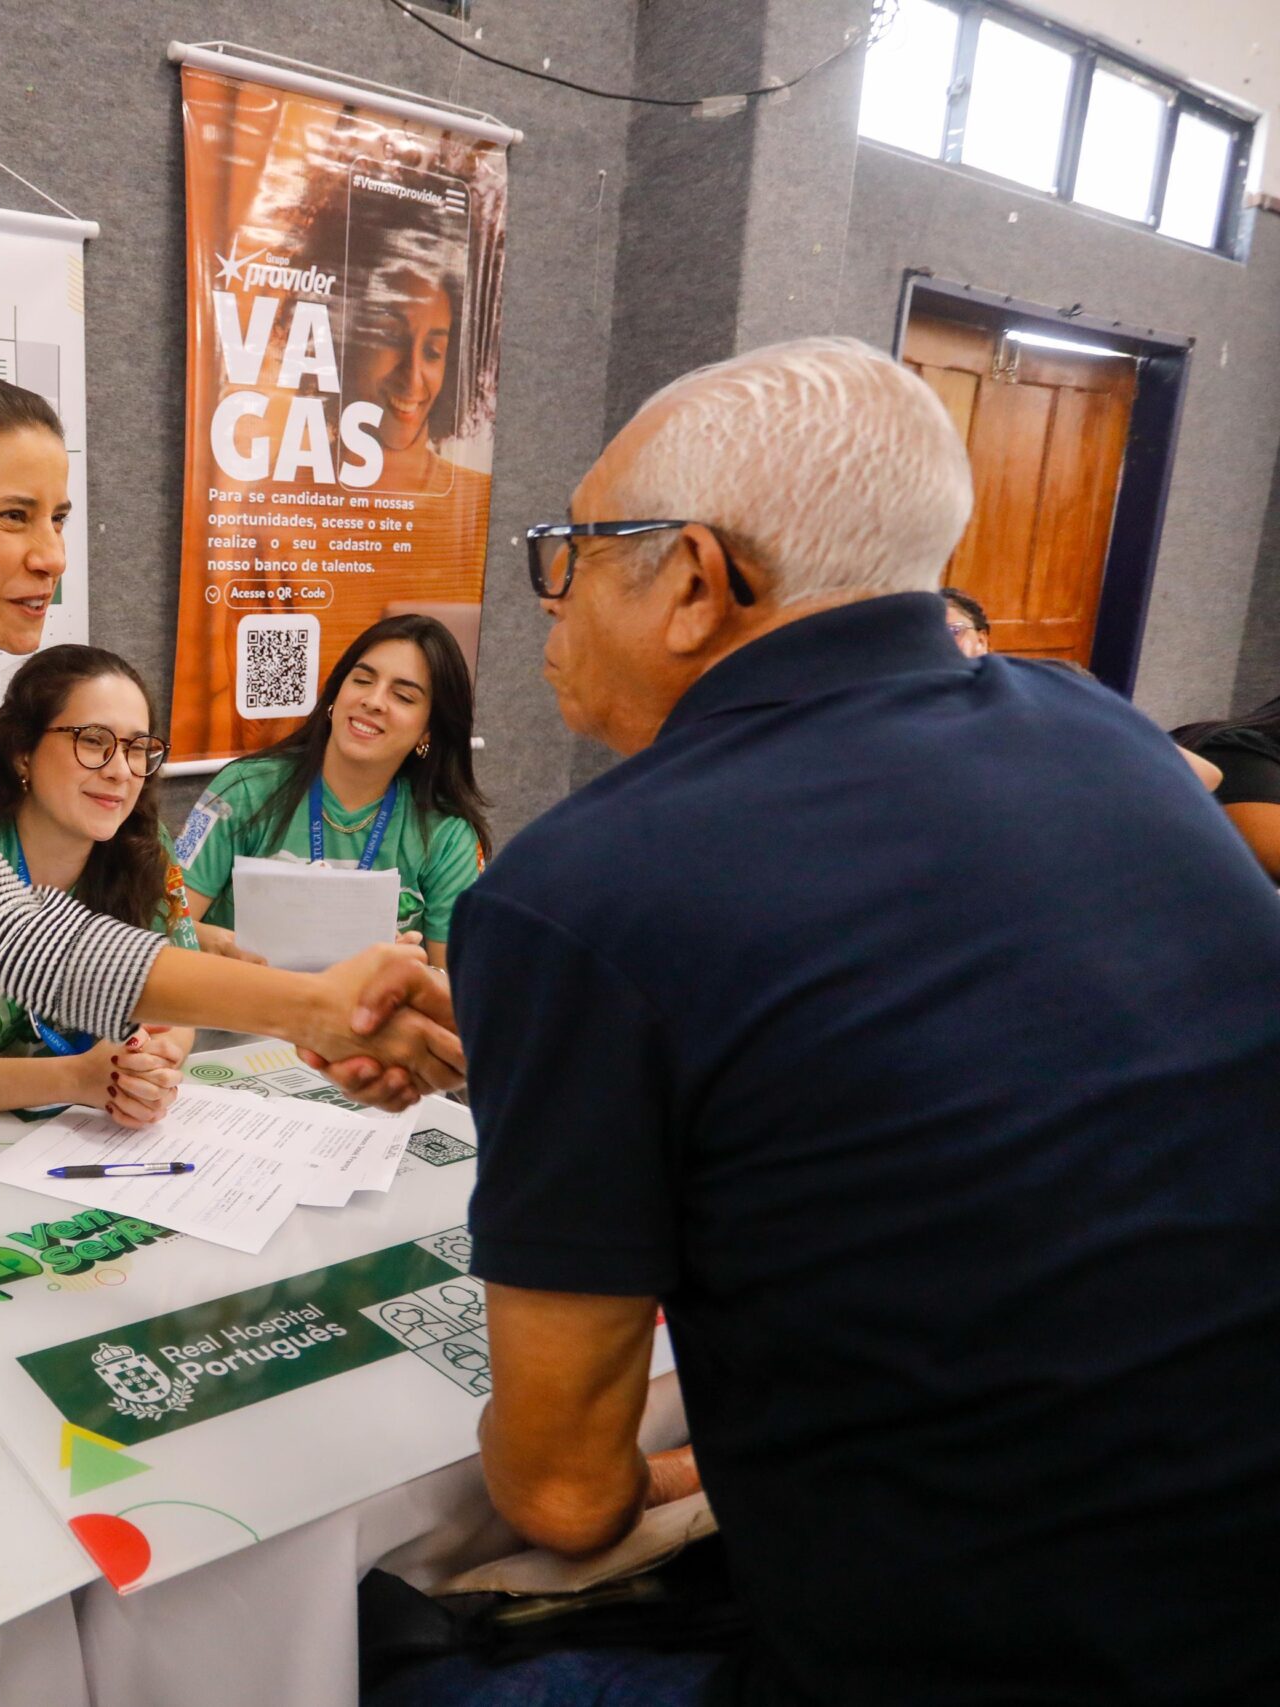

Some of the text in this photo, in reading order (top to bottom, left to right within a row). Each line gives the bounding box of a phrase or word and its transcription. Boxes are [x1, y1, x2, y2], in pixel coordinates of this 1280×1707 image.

[243, 263, 336, 295] provider
[212, 290, 341, 394] VA
[210, 391, 384, 487] GAS
[208, 488, 415, 511] Para se candidatar em nossas
[208, 512, 413, 532] oportunidades, acesse o site e
[208, 534, 412, 553] realize o seu cadastro em
[207, 558, 376, 574] nosso banco de talentos.
[230, 587, 265, 600] Acesse
[267, 590, 274, 600] o
[276, 587, 292, 601] QR
[300, 587, 326, 600] Code
[40, 1218, 169, 1274] SerR
[158, 1303, 325, 1363] Real Hospital
[176, 1322, 348, 1384] Português
